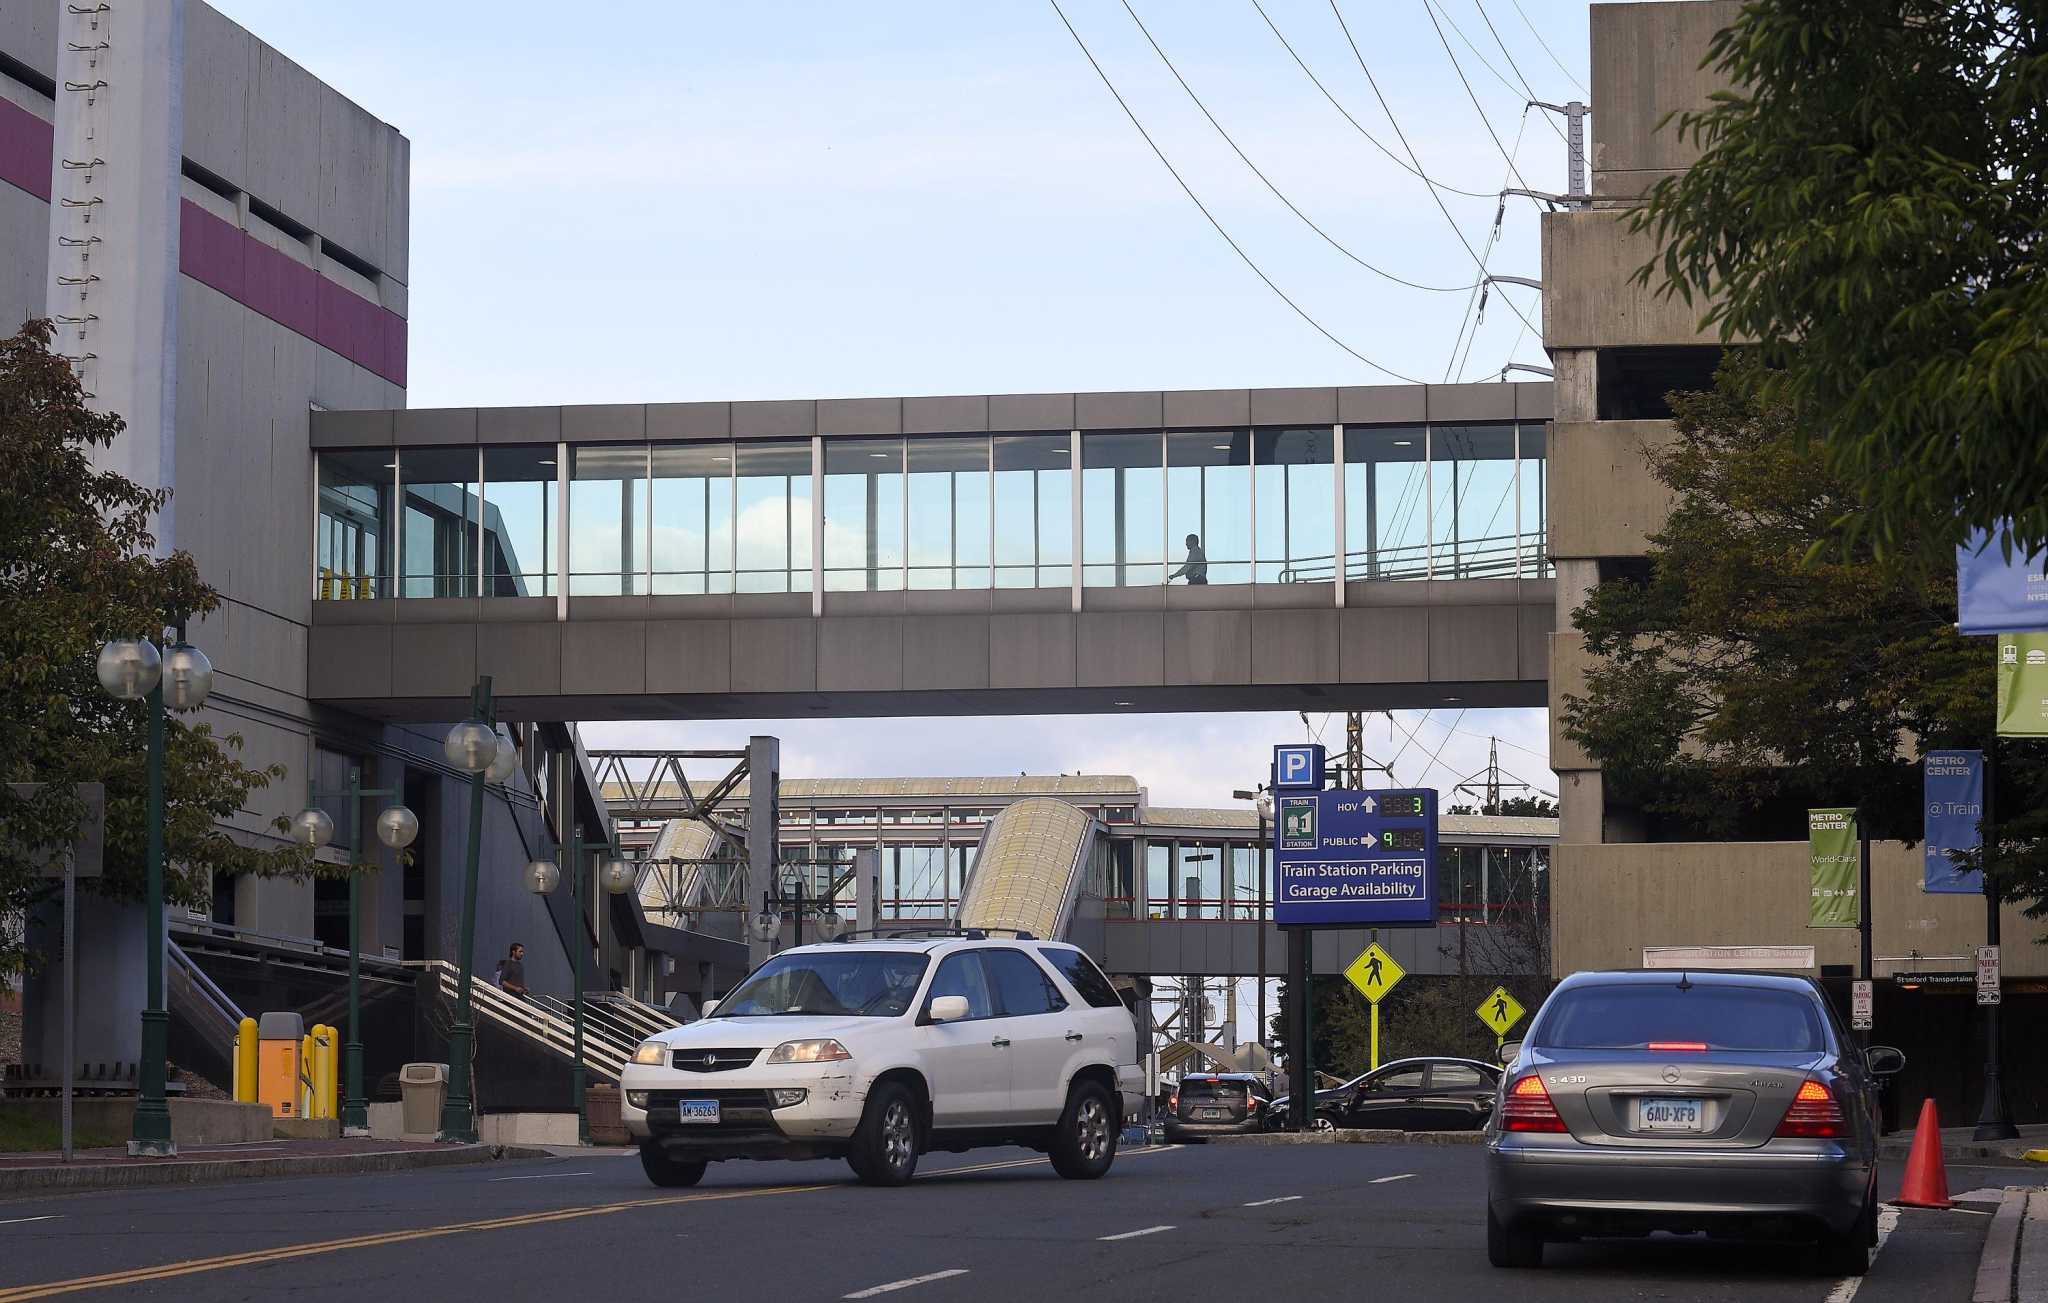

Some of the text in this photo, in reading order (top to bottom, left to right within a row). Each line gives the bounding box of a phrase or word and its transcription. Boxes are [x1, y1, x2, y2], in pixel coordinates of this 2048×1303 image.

[1926, 756, 1966, 765] METRO
[1287, 754, 1306, 780] P
[1926, 766, 1971, 776] CENTER
[1337, 803, 1359, 812] HOV
[1413, 797, 1422, 813] 3
[1944, 801, 1980, 815] Train
[1810, 813, 1843, 821] METRO
[1810, 822, 1848, 830] CENTER
[1322, 837, 1359, 846] PUBLIC
[1811, 855, 1857, 864] World-Class
[1282, 862, 1423, 878] Train Station Parking
[1288, 882, 1417, 899] Garage Availability
[1984, 949, 1993, 959] NO
[1858, 984, 1867, 992] NO
[1550, 1075, 1586, 1084] S 430
